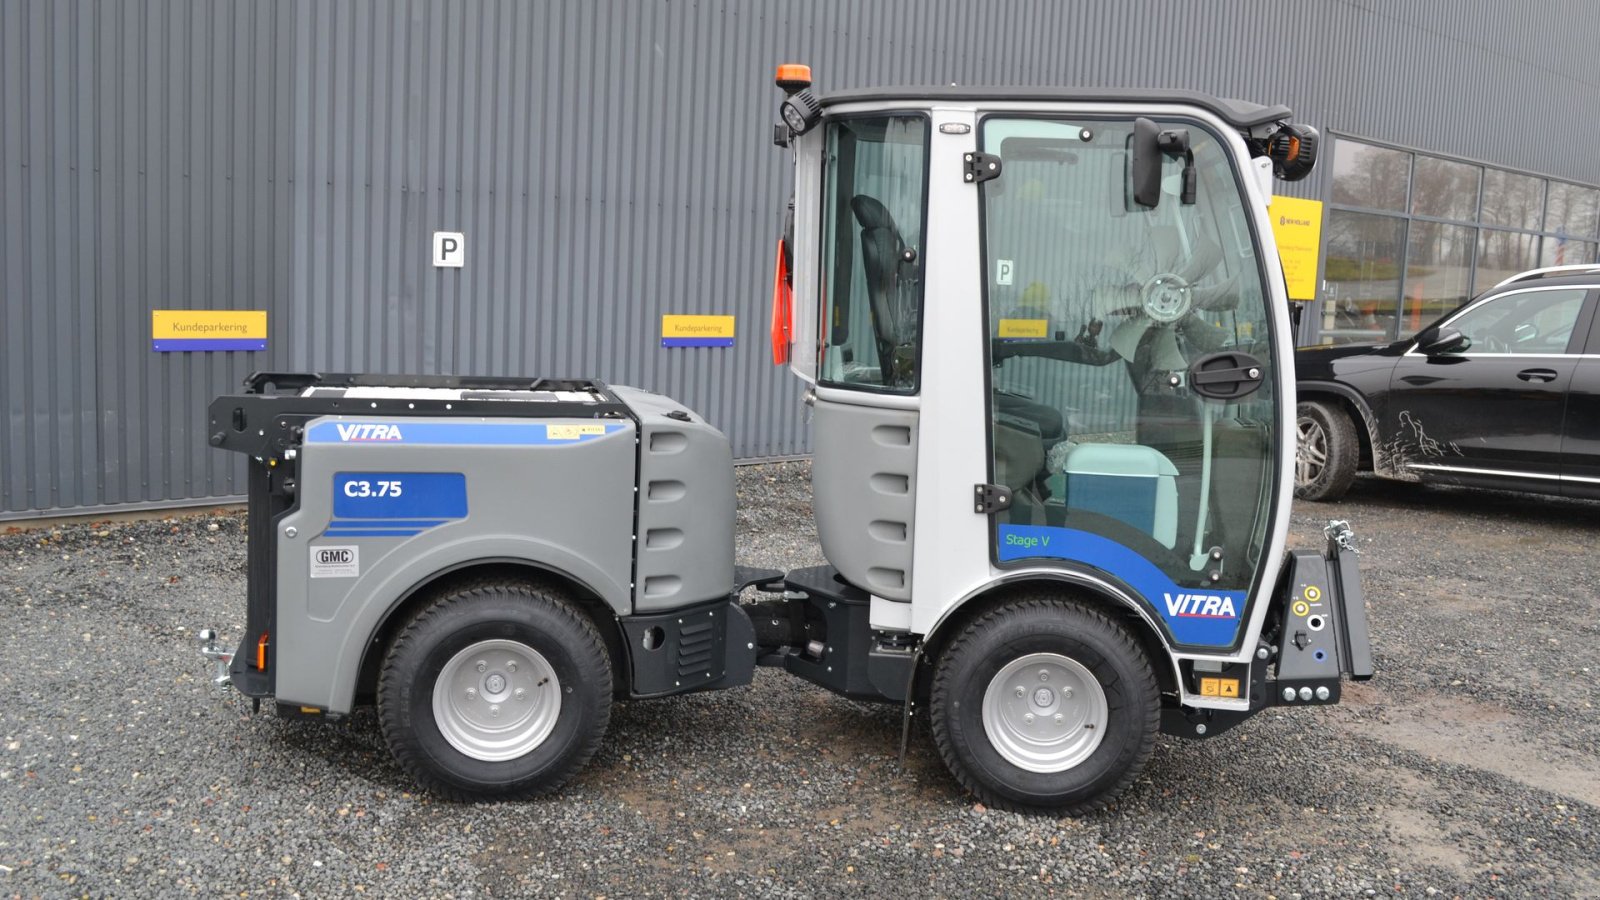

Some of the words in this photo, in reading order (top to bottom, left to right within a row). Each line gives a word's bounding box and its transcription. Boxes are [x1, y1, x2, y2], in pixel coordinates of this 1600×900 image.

[441, 238, 457, 260] P
[1000, 264, 1010, 280] P
[173, 322, 247, 333] Kundeparkering
[674, 324, 722, 333] Kundeparkering
[336, 424, 402, 441] VITRA
[344, 480, 402, 497] C3.75
[1006, 534, 1038, 548] Stage
[1041, 535, 1050, 546] V
[321, 550, 349, 563] GMC
[1163, 592, 1236, 617] VITRA
